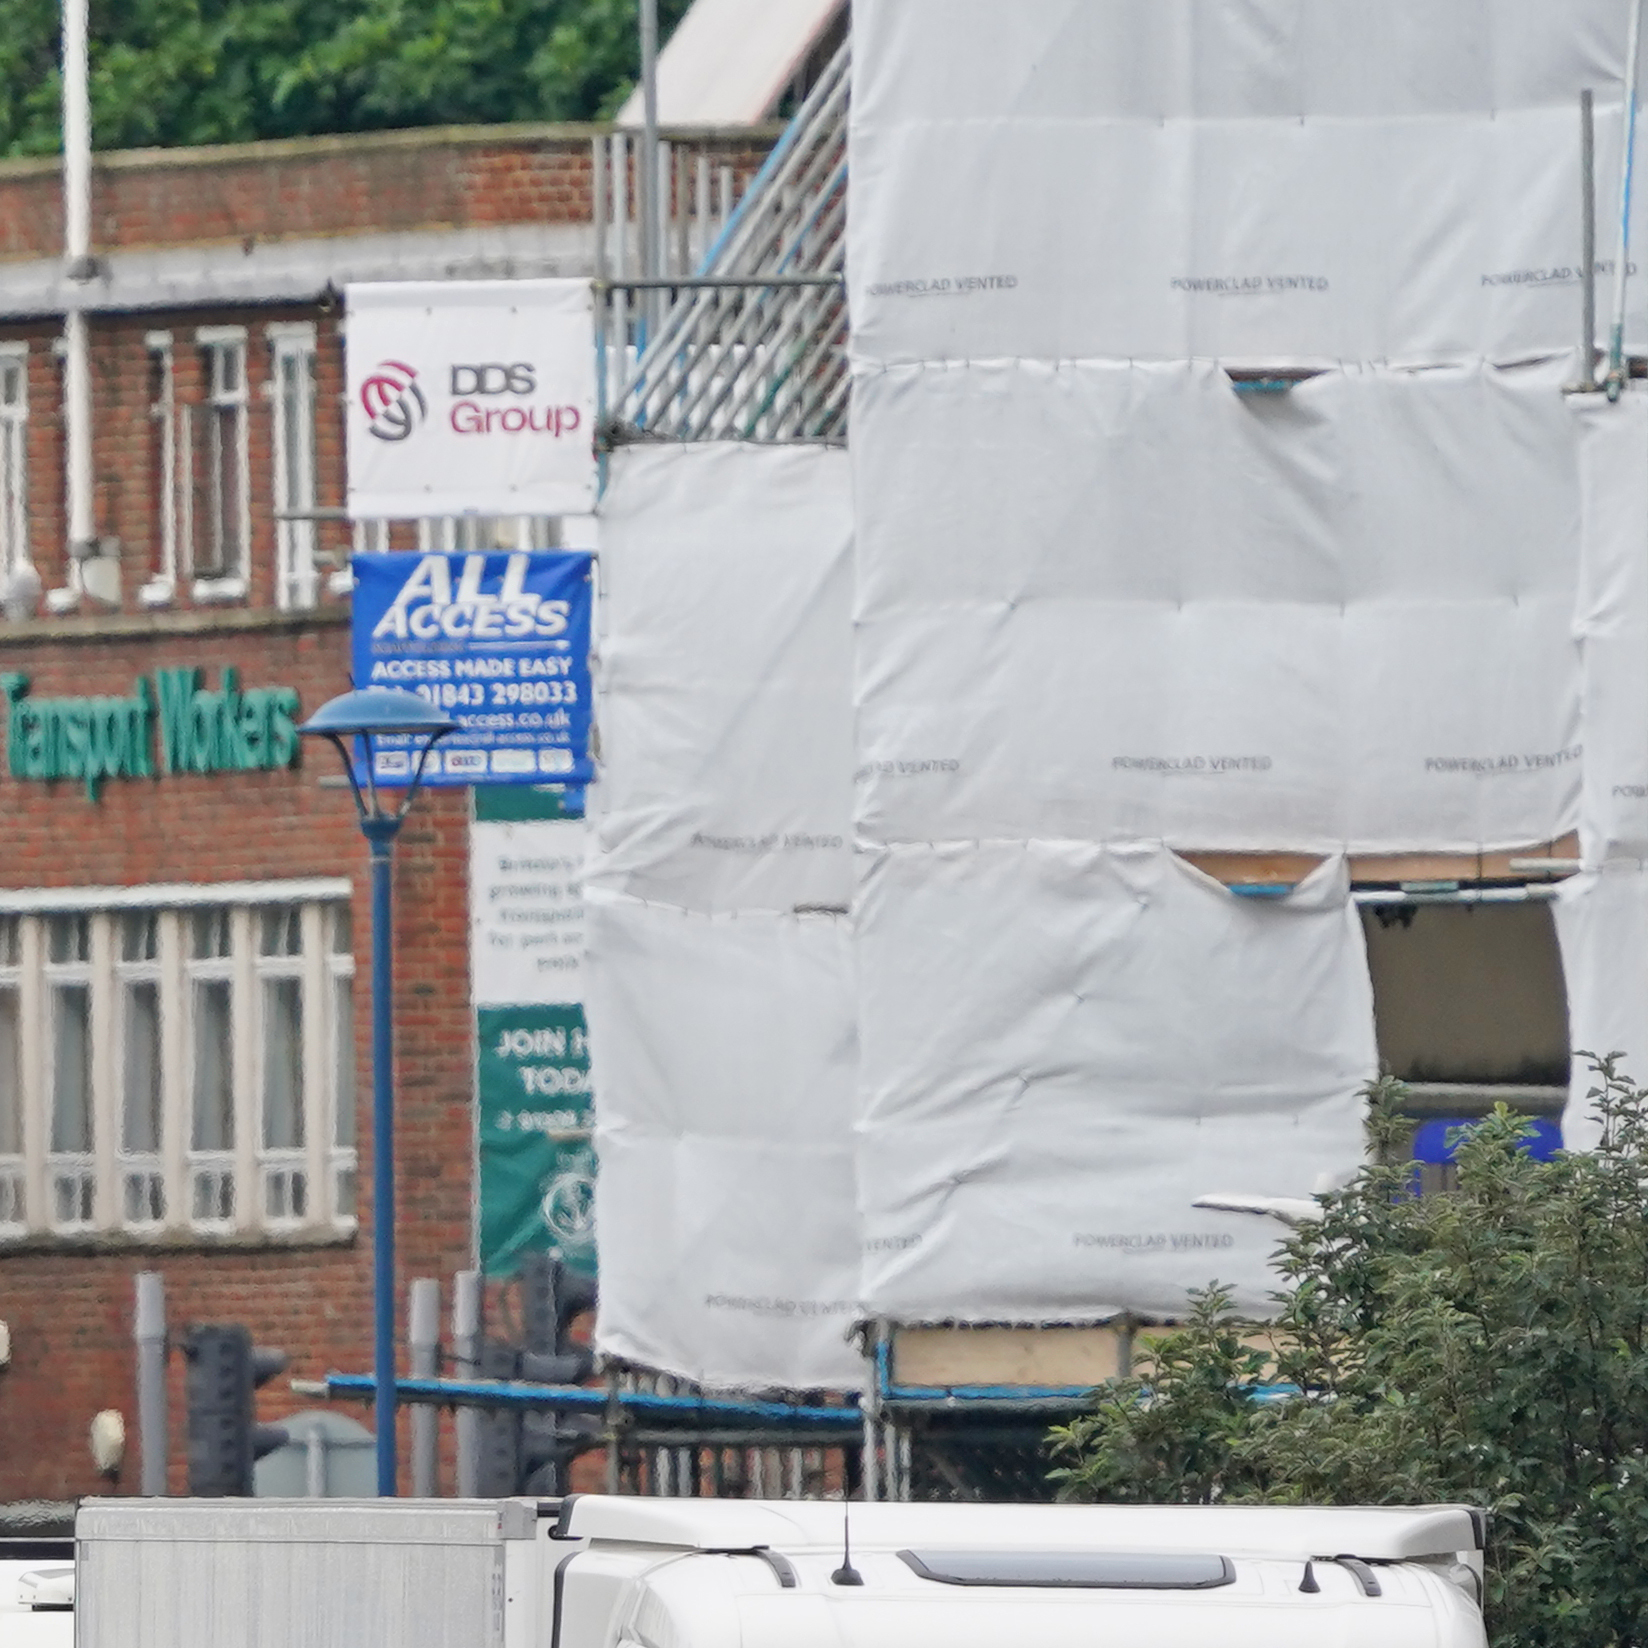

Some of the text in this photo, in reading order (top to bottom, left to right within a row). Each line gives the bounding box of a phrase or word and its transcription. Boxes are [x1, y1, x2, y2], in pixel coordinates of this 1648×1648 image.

[955, 275, 1018, 290] VENTED
[451, 362, 537, 395] DDS
[451, 401, 580, 438] Group
[394, 553, 542, 604] ALL
[372, 600, 571, 639] ACCESS
[372, 655, 573, 681] ACCESS MADE EASY
[415, 680, 578, 707] 01843 298033
[158, 665, 302, 772] Workers
[495, 1026, 567, 1059] JOIN
